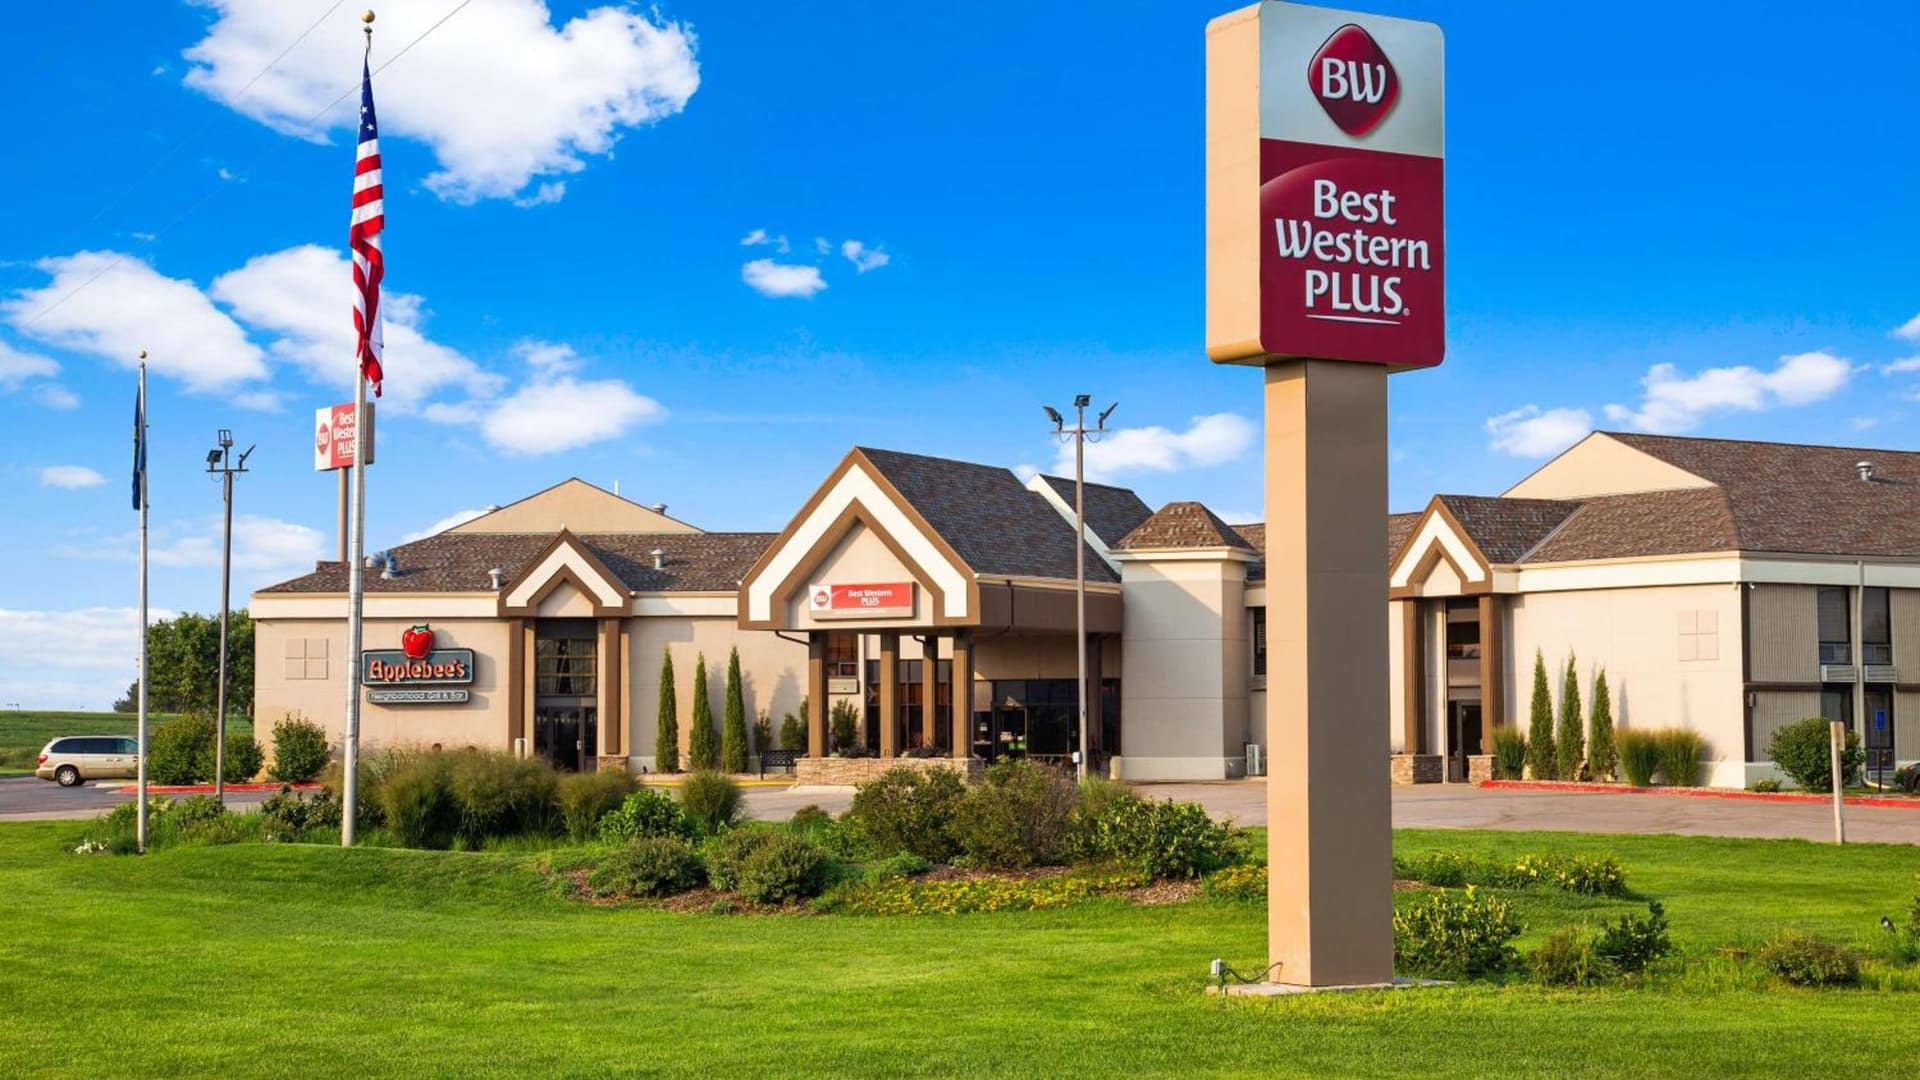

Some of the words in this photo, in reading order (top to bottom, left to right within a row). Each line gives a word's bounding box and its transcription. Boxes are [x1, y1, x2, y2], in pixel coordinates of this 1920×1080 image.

[1321, 57, 1386, 104] BW
[1313, 179, 1397, 225] Best
[1275, 218, 1431, 270] Western
[368, 660, 466, 683] Applebee's
